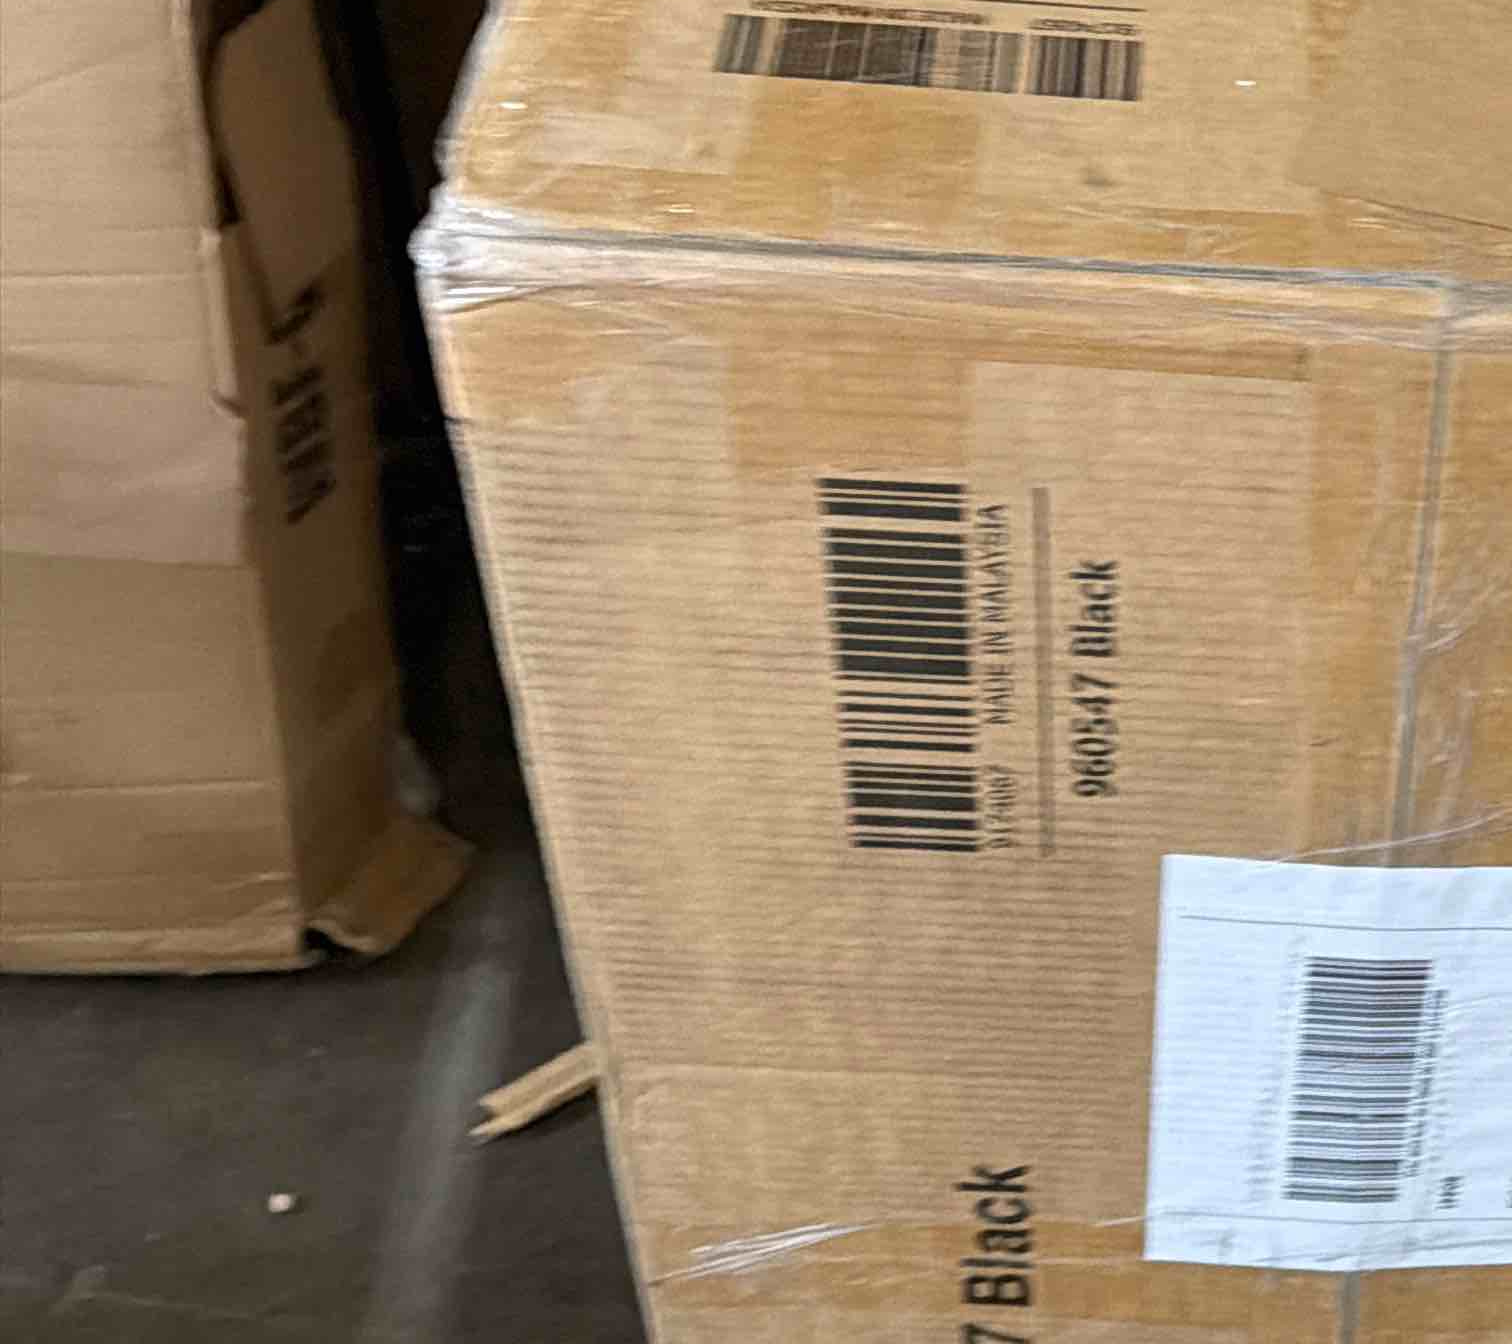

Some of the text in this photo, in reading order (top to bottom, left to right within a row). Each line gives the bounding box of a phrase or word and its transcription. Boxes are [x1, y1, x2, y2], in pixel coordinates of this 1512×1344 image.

[974, 503, 1013, 624] MALAYSIA
[979, 662, 1014, 725] MADE
[981, 630, 1014, 656] IN
[1068, 559, 1120, 799] 960547 Black
[955, 1163, 1035, 1308] Black
